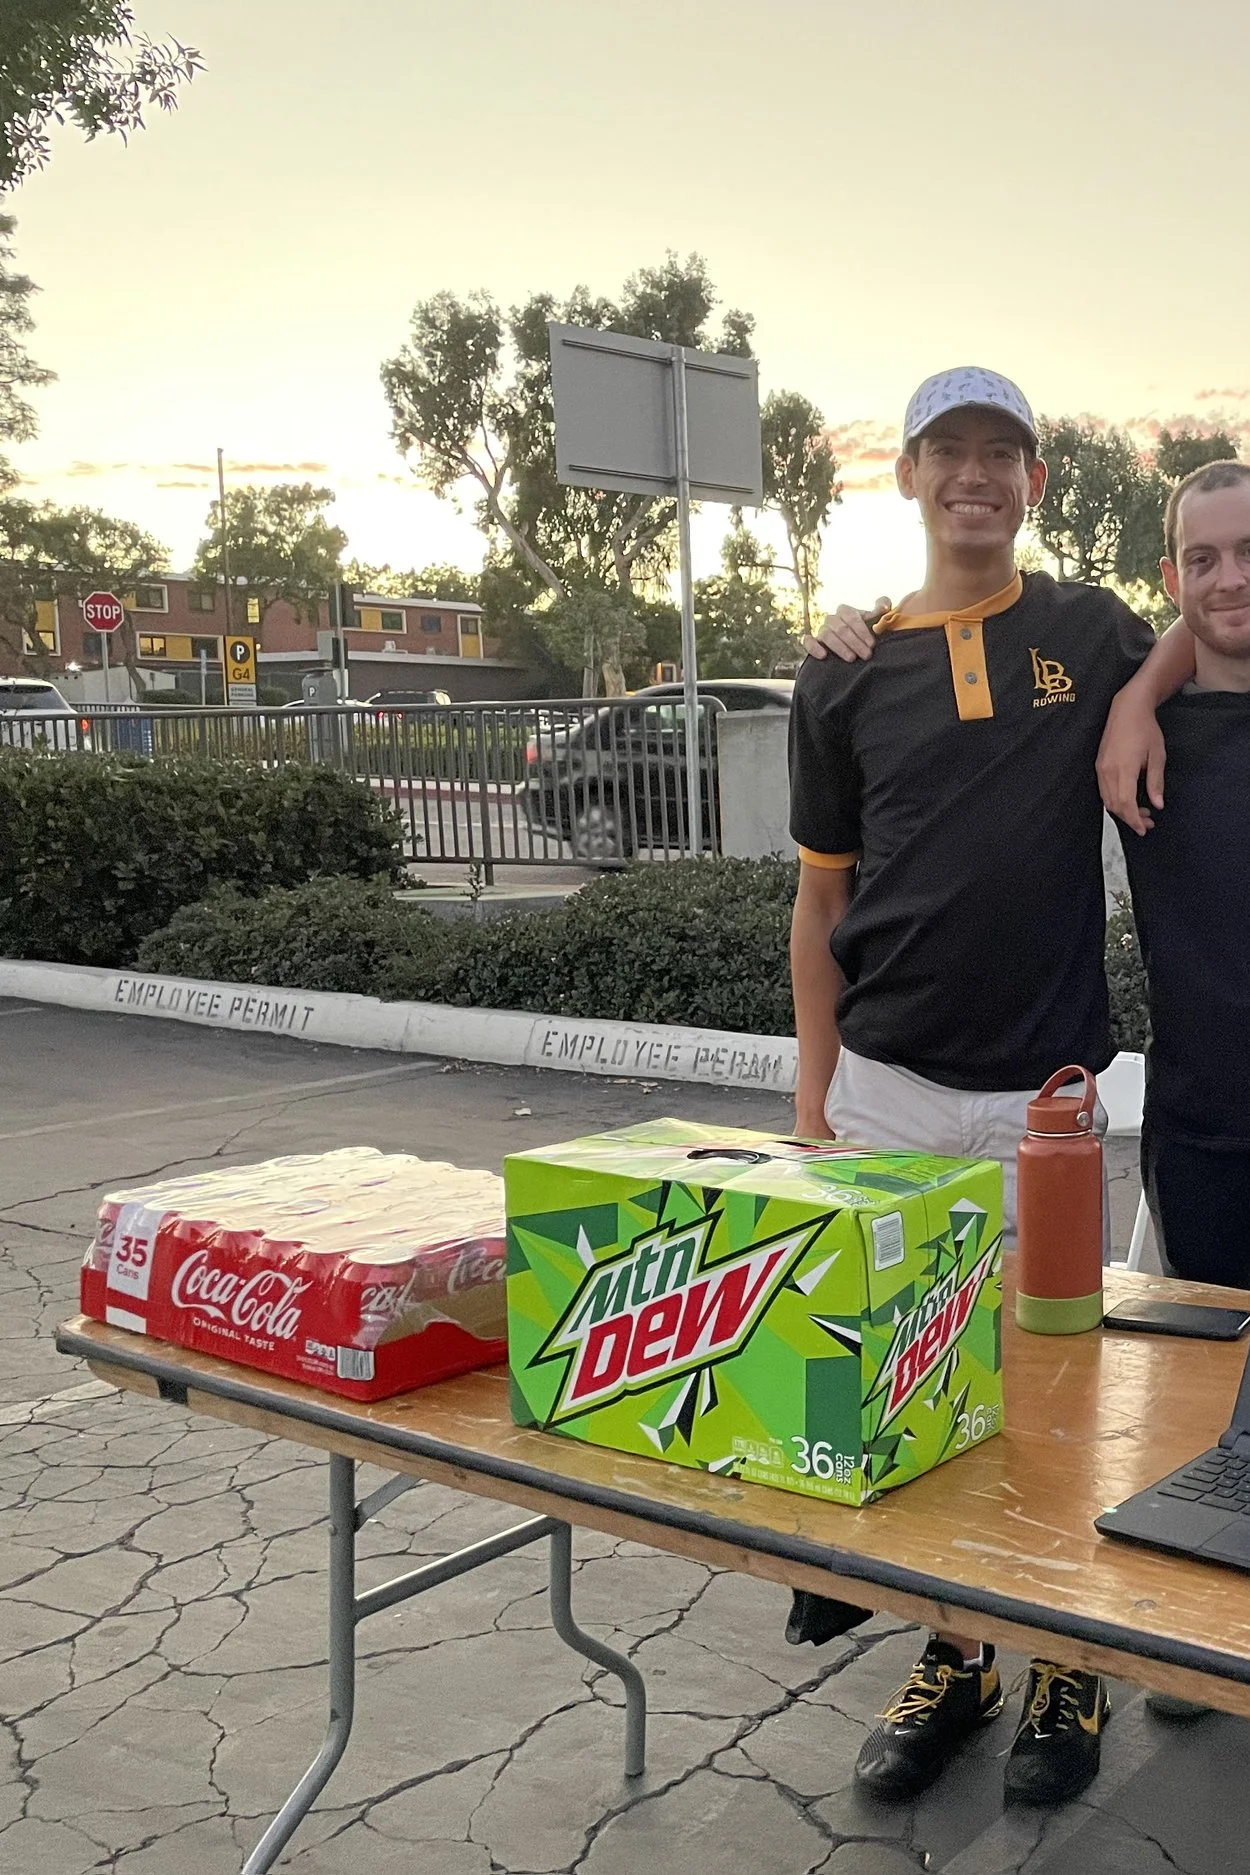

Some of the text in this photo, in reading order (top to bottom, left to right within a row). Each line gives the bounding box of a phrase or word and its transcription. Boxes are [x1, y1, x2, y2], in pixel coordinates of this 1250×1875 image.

[87, 604, 121, 620] STOP
[236, 645, 245, 661] P
[232, 668, 251, 680] G4
[114, 979, 315, 1032] EMPLOYEE PERMIT
[541, 1030, 682, 1072] EMPLOYEE
[116, 1235, 149, 1268] 35
[116, 1263, 140, 1280] Cans
[171, 1249, 314, 1340] Coca-Cola
[192, 1317, 275, 1352] ORIGINAL TASTE
[955, 1404, 986, 1450] 36
[790, 1435, 834, 1480] 36
[835, 1453, 844, 1484] cans
